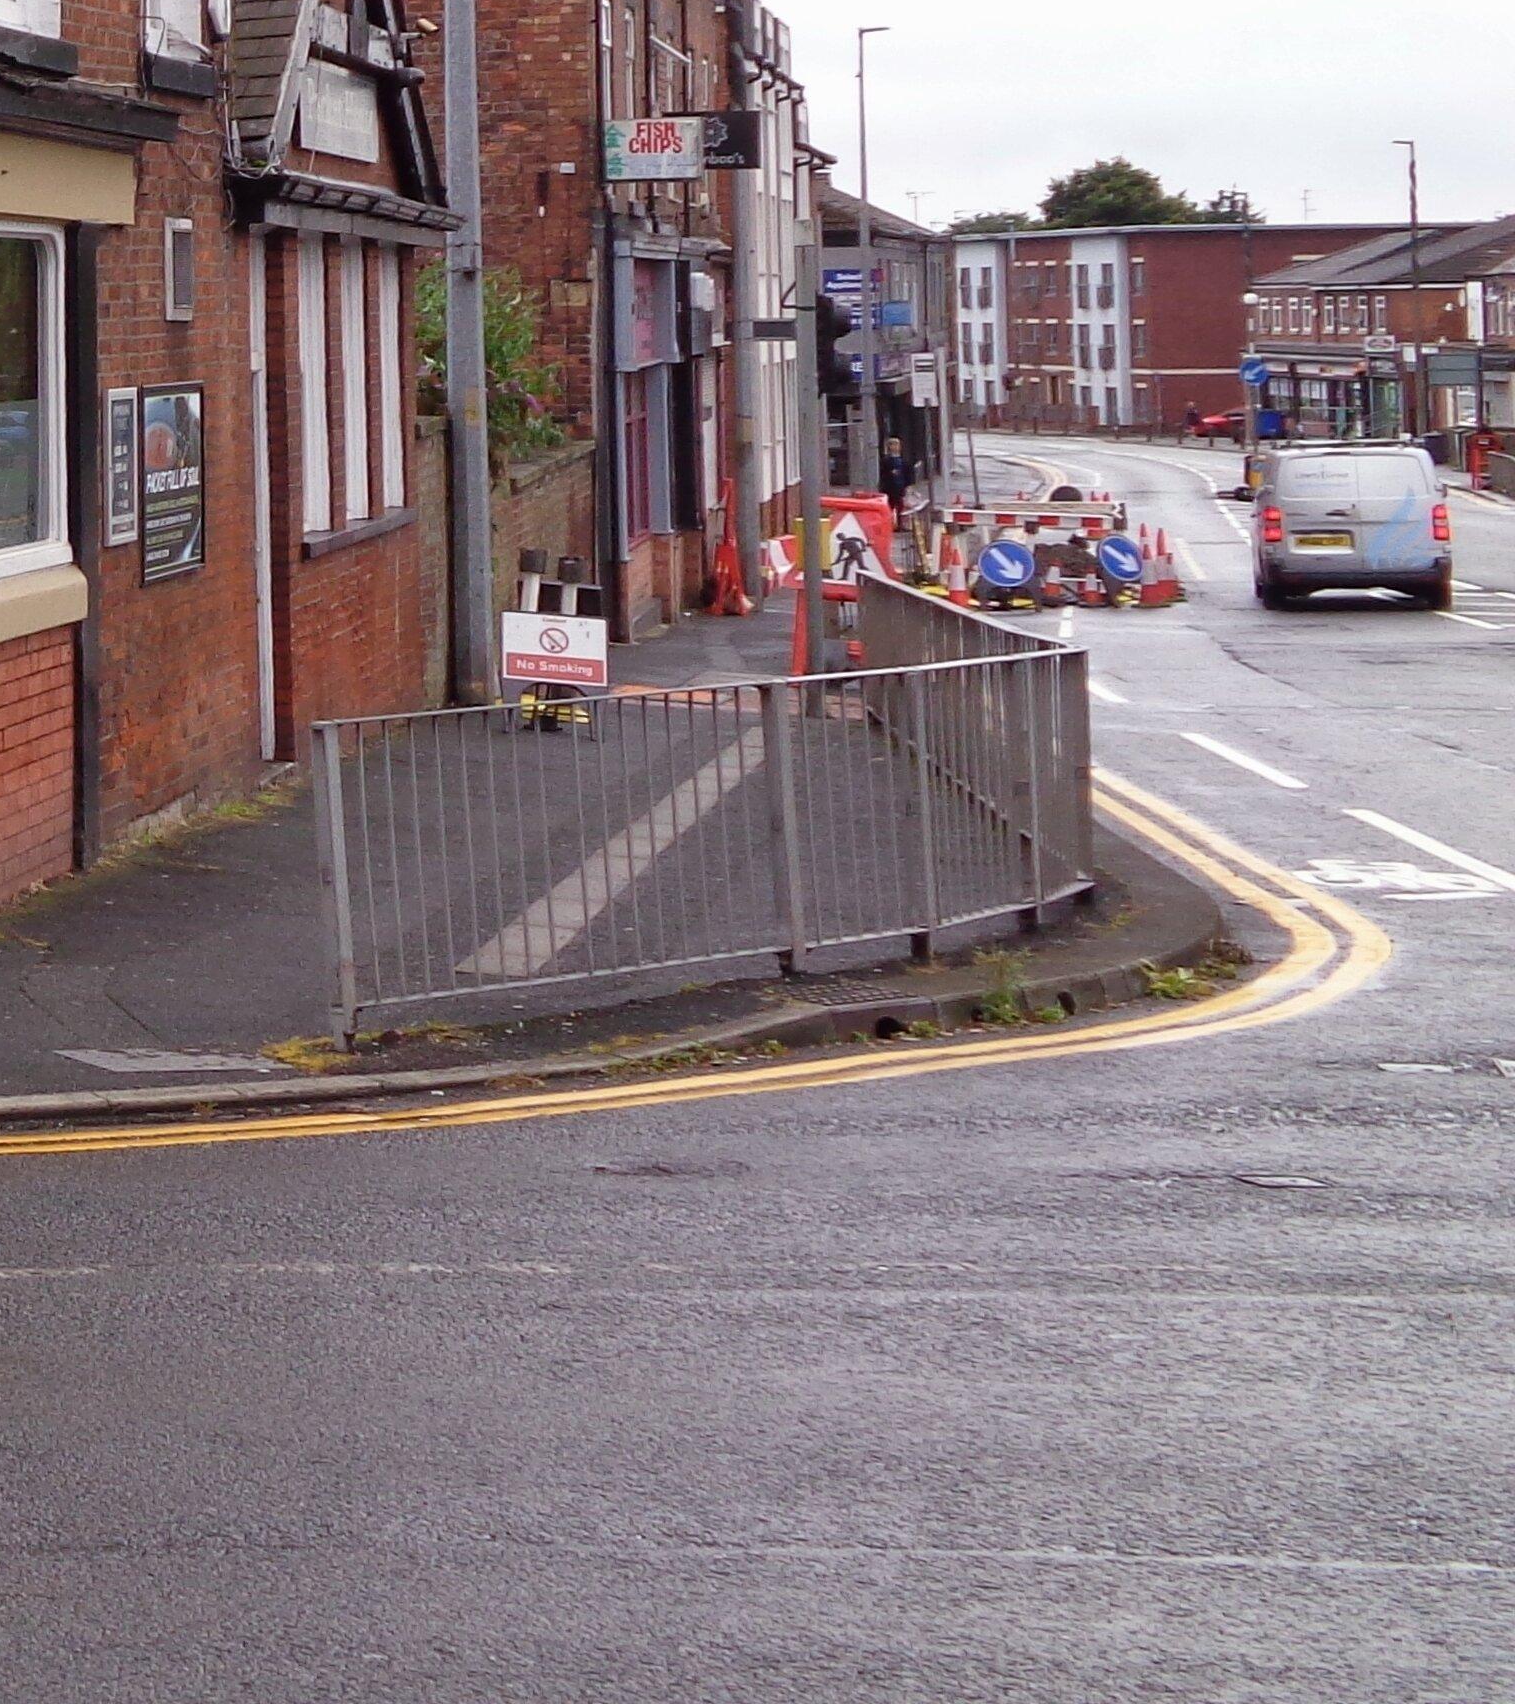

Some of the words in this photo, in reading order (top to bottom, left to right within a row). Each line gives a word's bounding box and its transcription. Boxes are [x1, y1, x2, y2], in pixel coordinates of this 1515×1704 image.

[636, 121, 676, 138] FISH
[629, 136, 683, 154] CHIPS
[516, 659, 536, 670] No
[539, 661, 593, 677] Smoking
